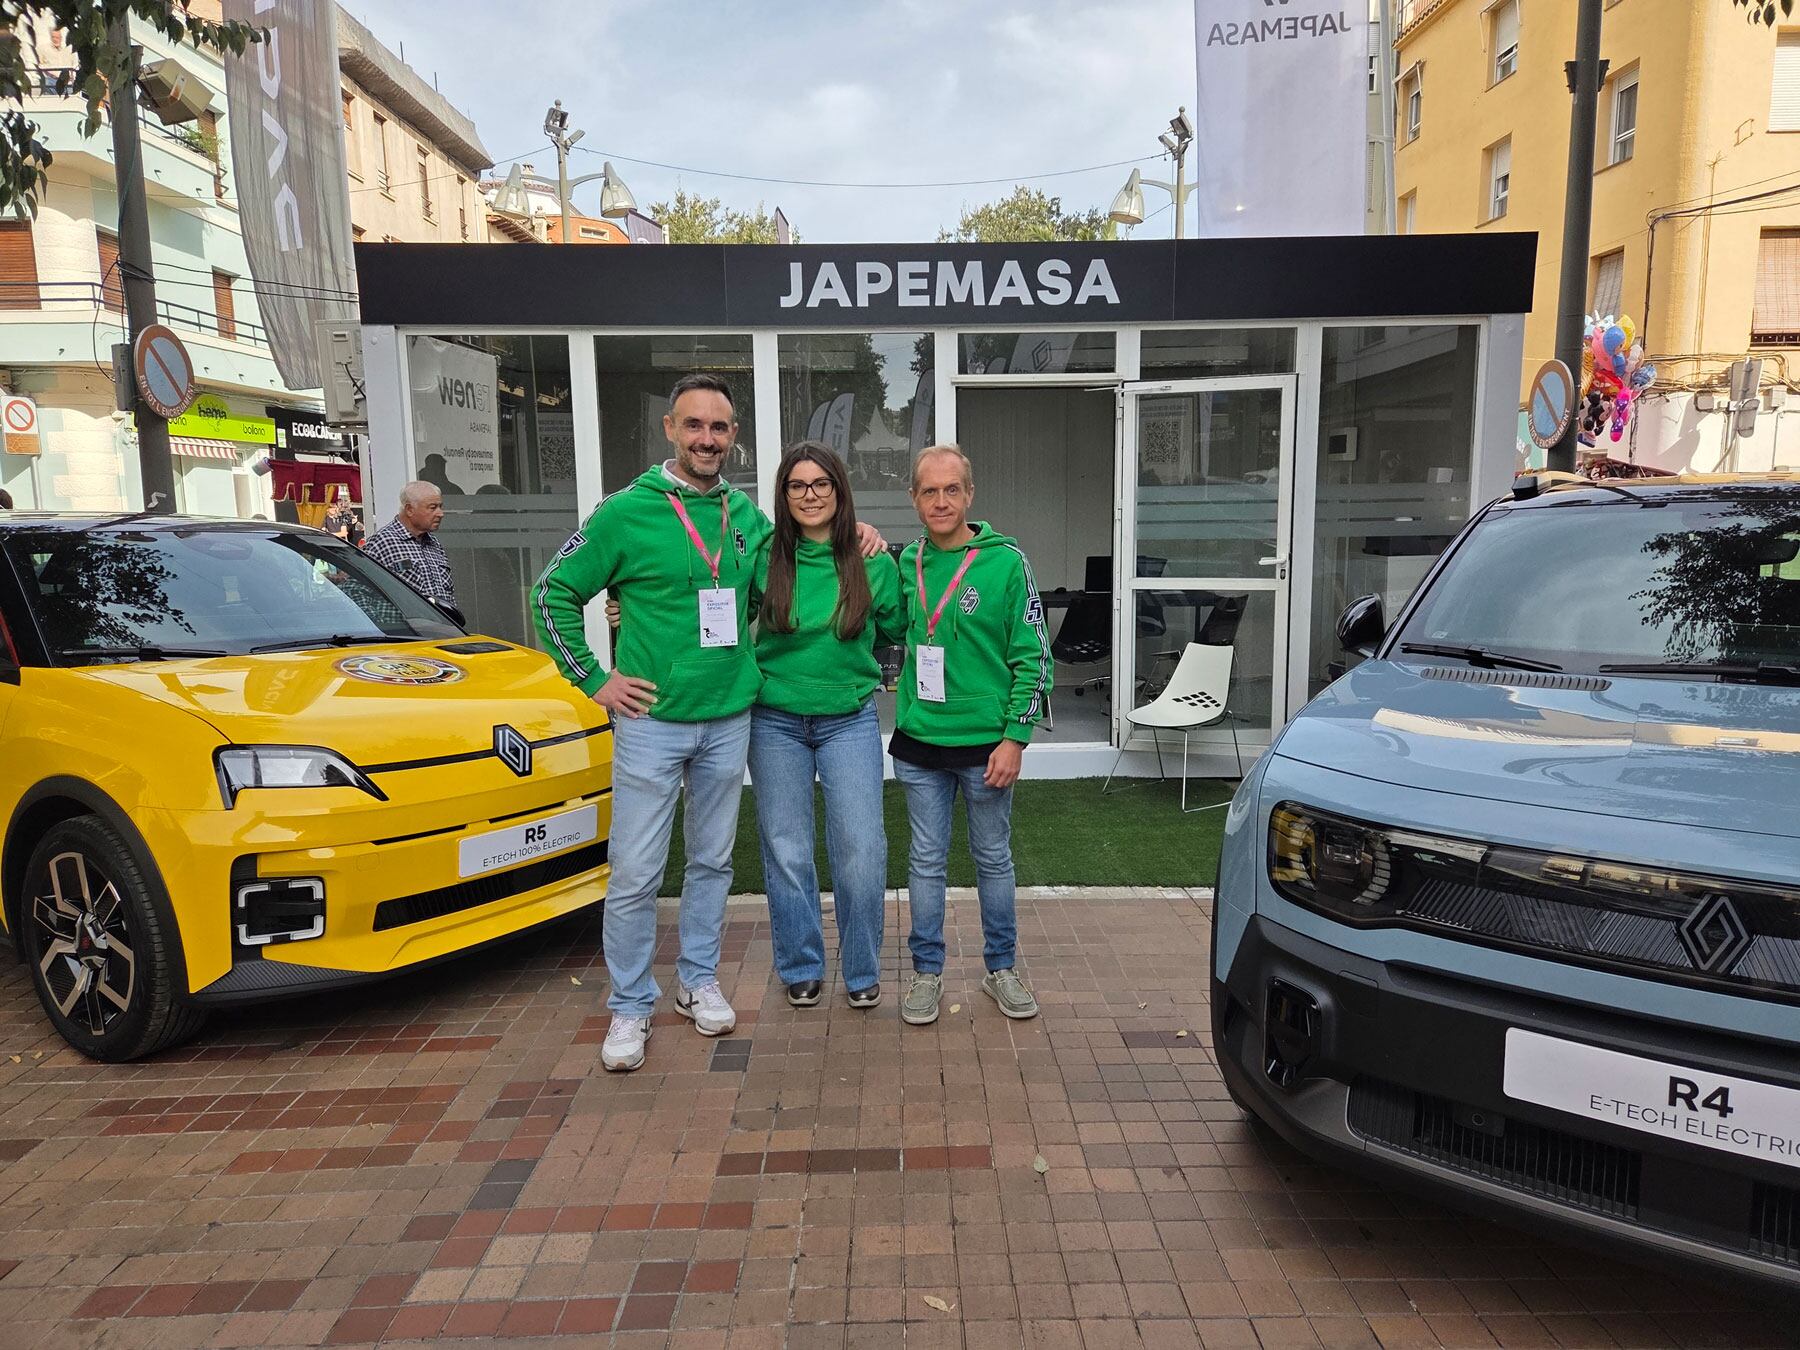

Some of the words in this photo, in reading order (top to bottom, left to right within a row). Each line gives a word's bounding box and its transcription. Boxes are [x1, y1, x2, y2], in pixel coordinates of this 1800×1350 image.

[780, 258, 1121, 307] JAPEMASA
[139, 374, 148, 389] EN
[145, 390, 157, 405] TOT
[1025, 598, 1043, 622] 5
[483, 849, 517, 868] E-TECH
[518, 844, 542, 857] 100%
[542, 831, 581, 851] ELECTRIC
[525, 824, 547, 845] R5
[1668, 1075, 1734, 1119] R4
[1590, 1094, 1677, 1129] E-TECH
[1685, 1117, 1800, 1158] ELECTRI
